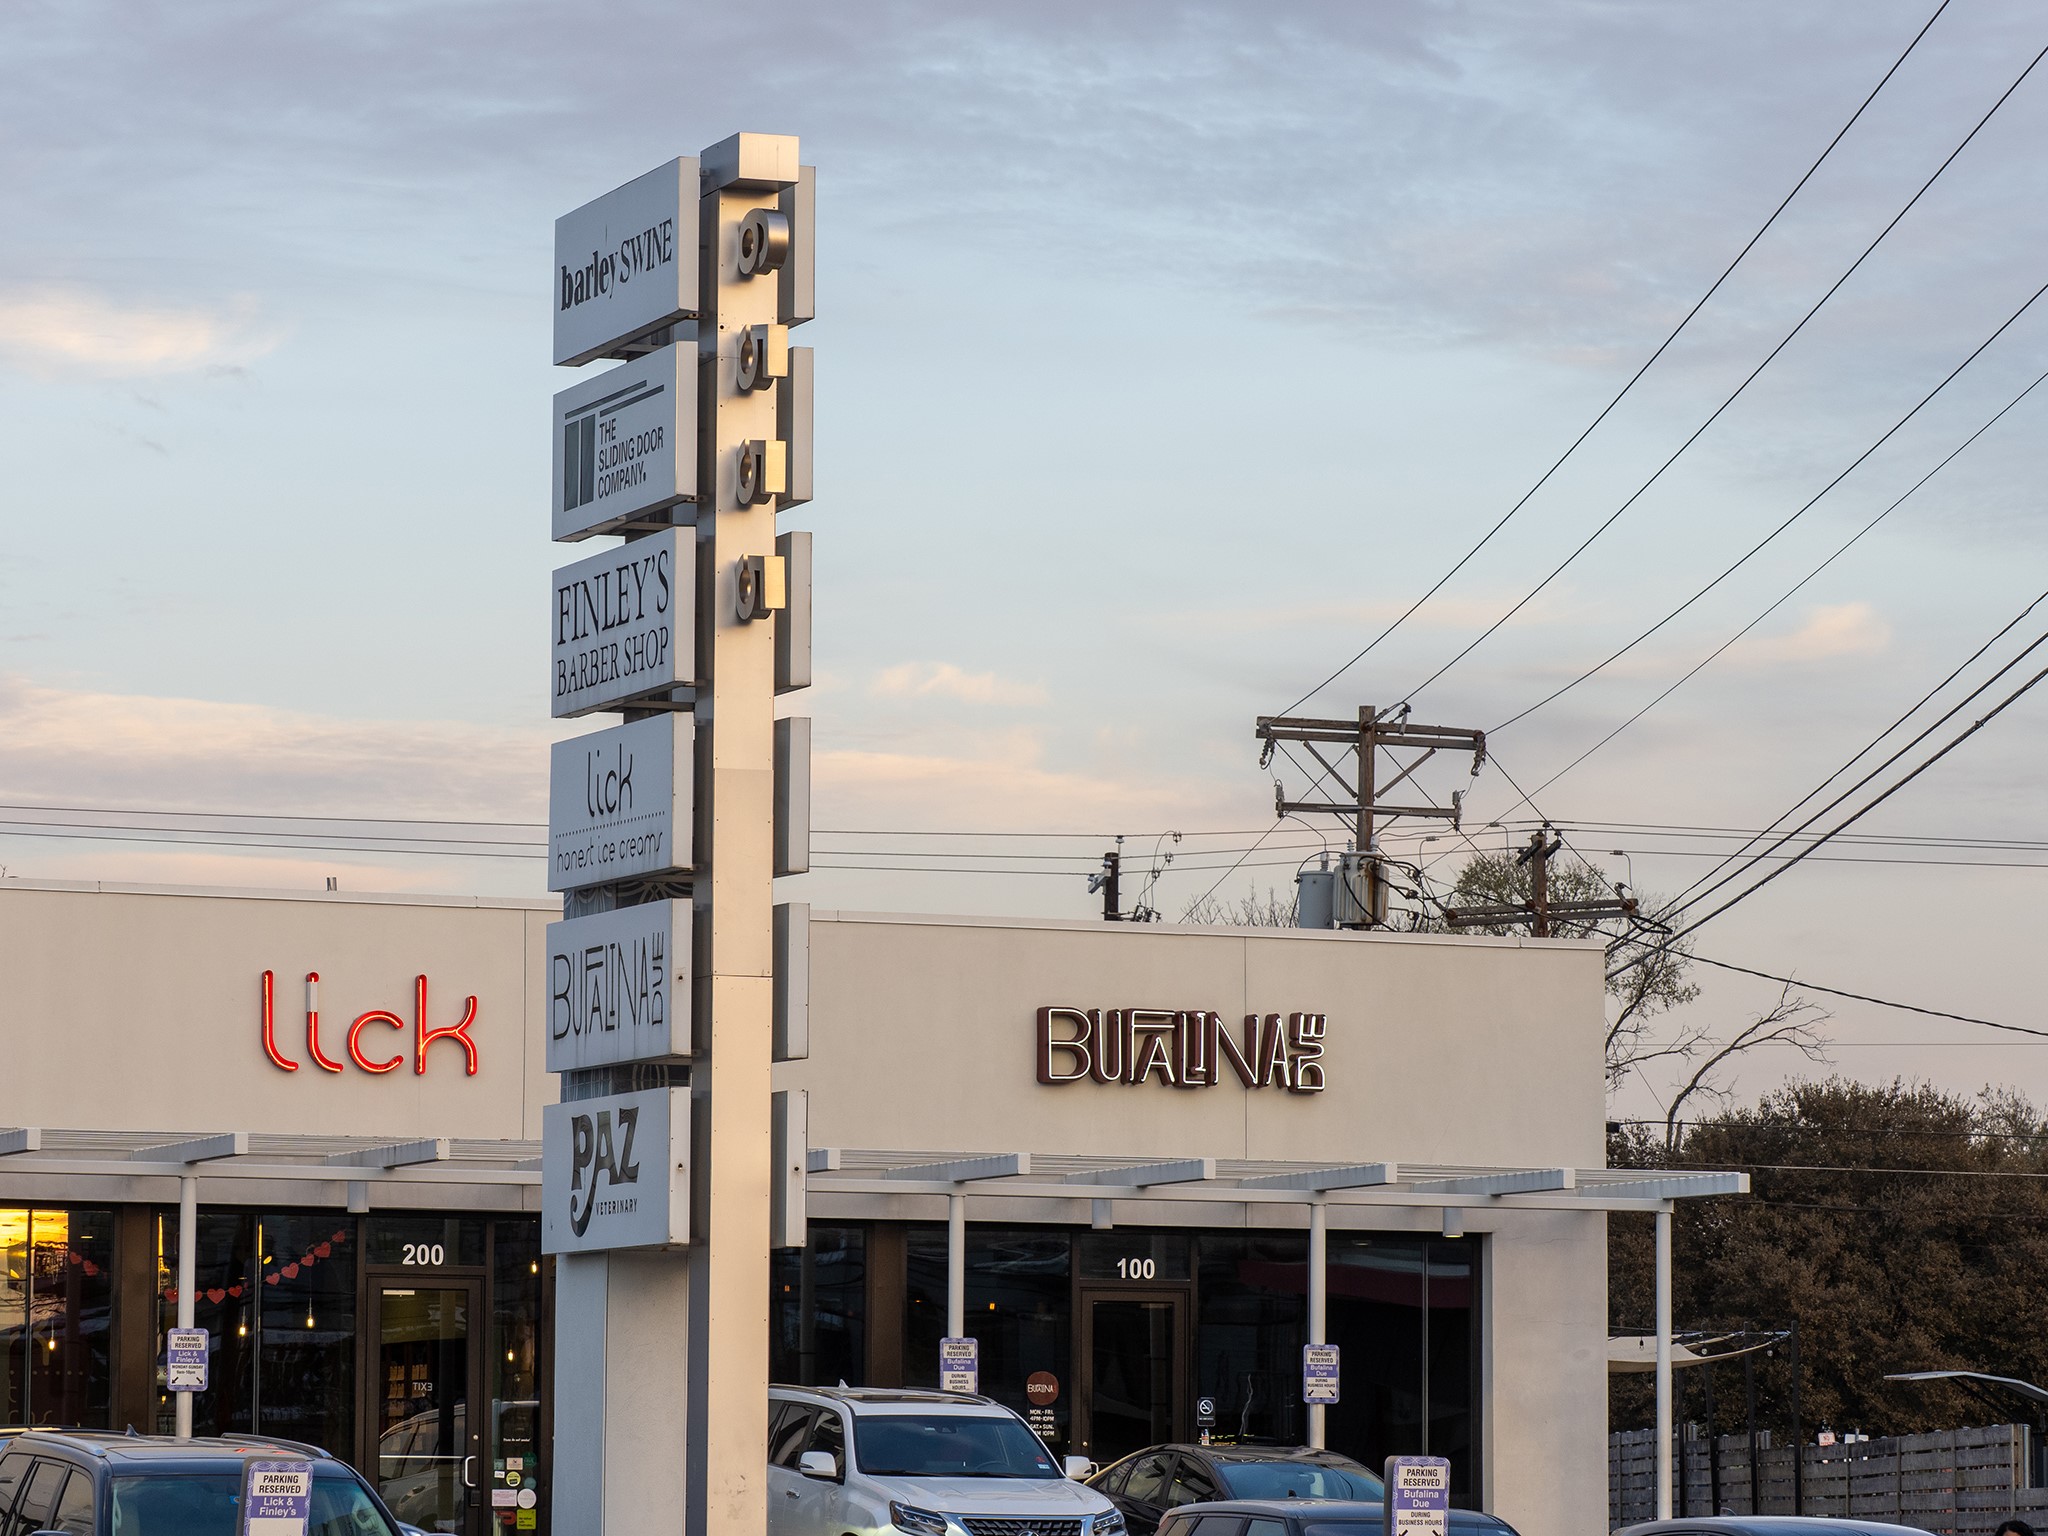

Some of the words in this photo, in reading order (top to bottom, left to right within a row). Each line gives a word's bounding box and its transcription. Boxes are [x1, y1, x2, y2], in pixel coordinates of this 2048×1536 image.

[561, 250, 618, 311] barley
[620, 217, 672, 283] SWINE
[599, 418, 617, 445] THE
[598, 437, 635, 472] SLIDING
[636, 426, 664, 458] DOOR
[557, 549, 669, 646] FINLEY'S
[557, 643, 621, 697] BARBER
[624, 626, 669, 676] SHOP
[587, 743, 633, 817] lick
[556, 836, 594, 872] honest
[597, 835, 616, 864] ice
[619, 831, 663, 860] creams
[553, 936, 650, 1040] BUFALINA
[651, 931, 665, 1026] DUE
[261, 969, 478, 1076] lick
[1037, 1006, 1292, 1090] BUFALINA
[1288, 1012, 1327, 1094] DUE
[570, 1106, 640, 1238] PAZ
[595, 1198, 638, 1216] VETERINARY
[402, 1243, 444, 1266] 200
[1117, 1257, 1156, 1280] 100
[176, 1356, 200, 1364] Finley's
[263, 1474, 299, 1484] PARKING
[1403, 1478, 1440, 1487] RESERVED
[1406, 1468, 1438, 1477] PARKING
[258, 1484, 302, 1494] RESERVED
[1403, 1489, 1439, 1499] Bufalina
[259, 1506, 297, 1518] Finley's
[263, 1496, 284, 1506] Lick
[286, 1497, 294, 1506] &
[1412, 1498, 1430, 1508] Due
